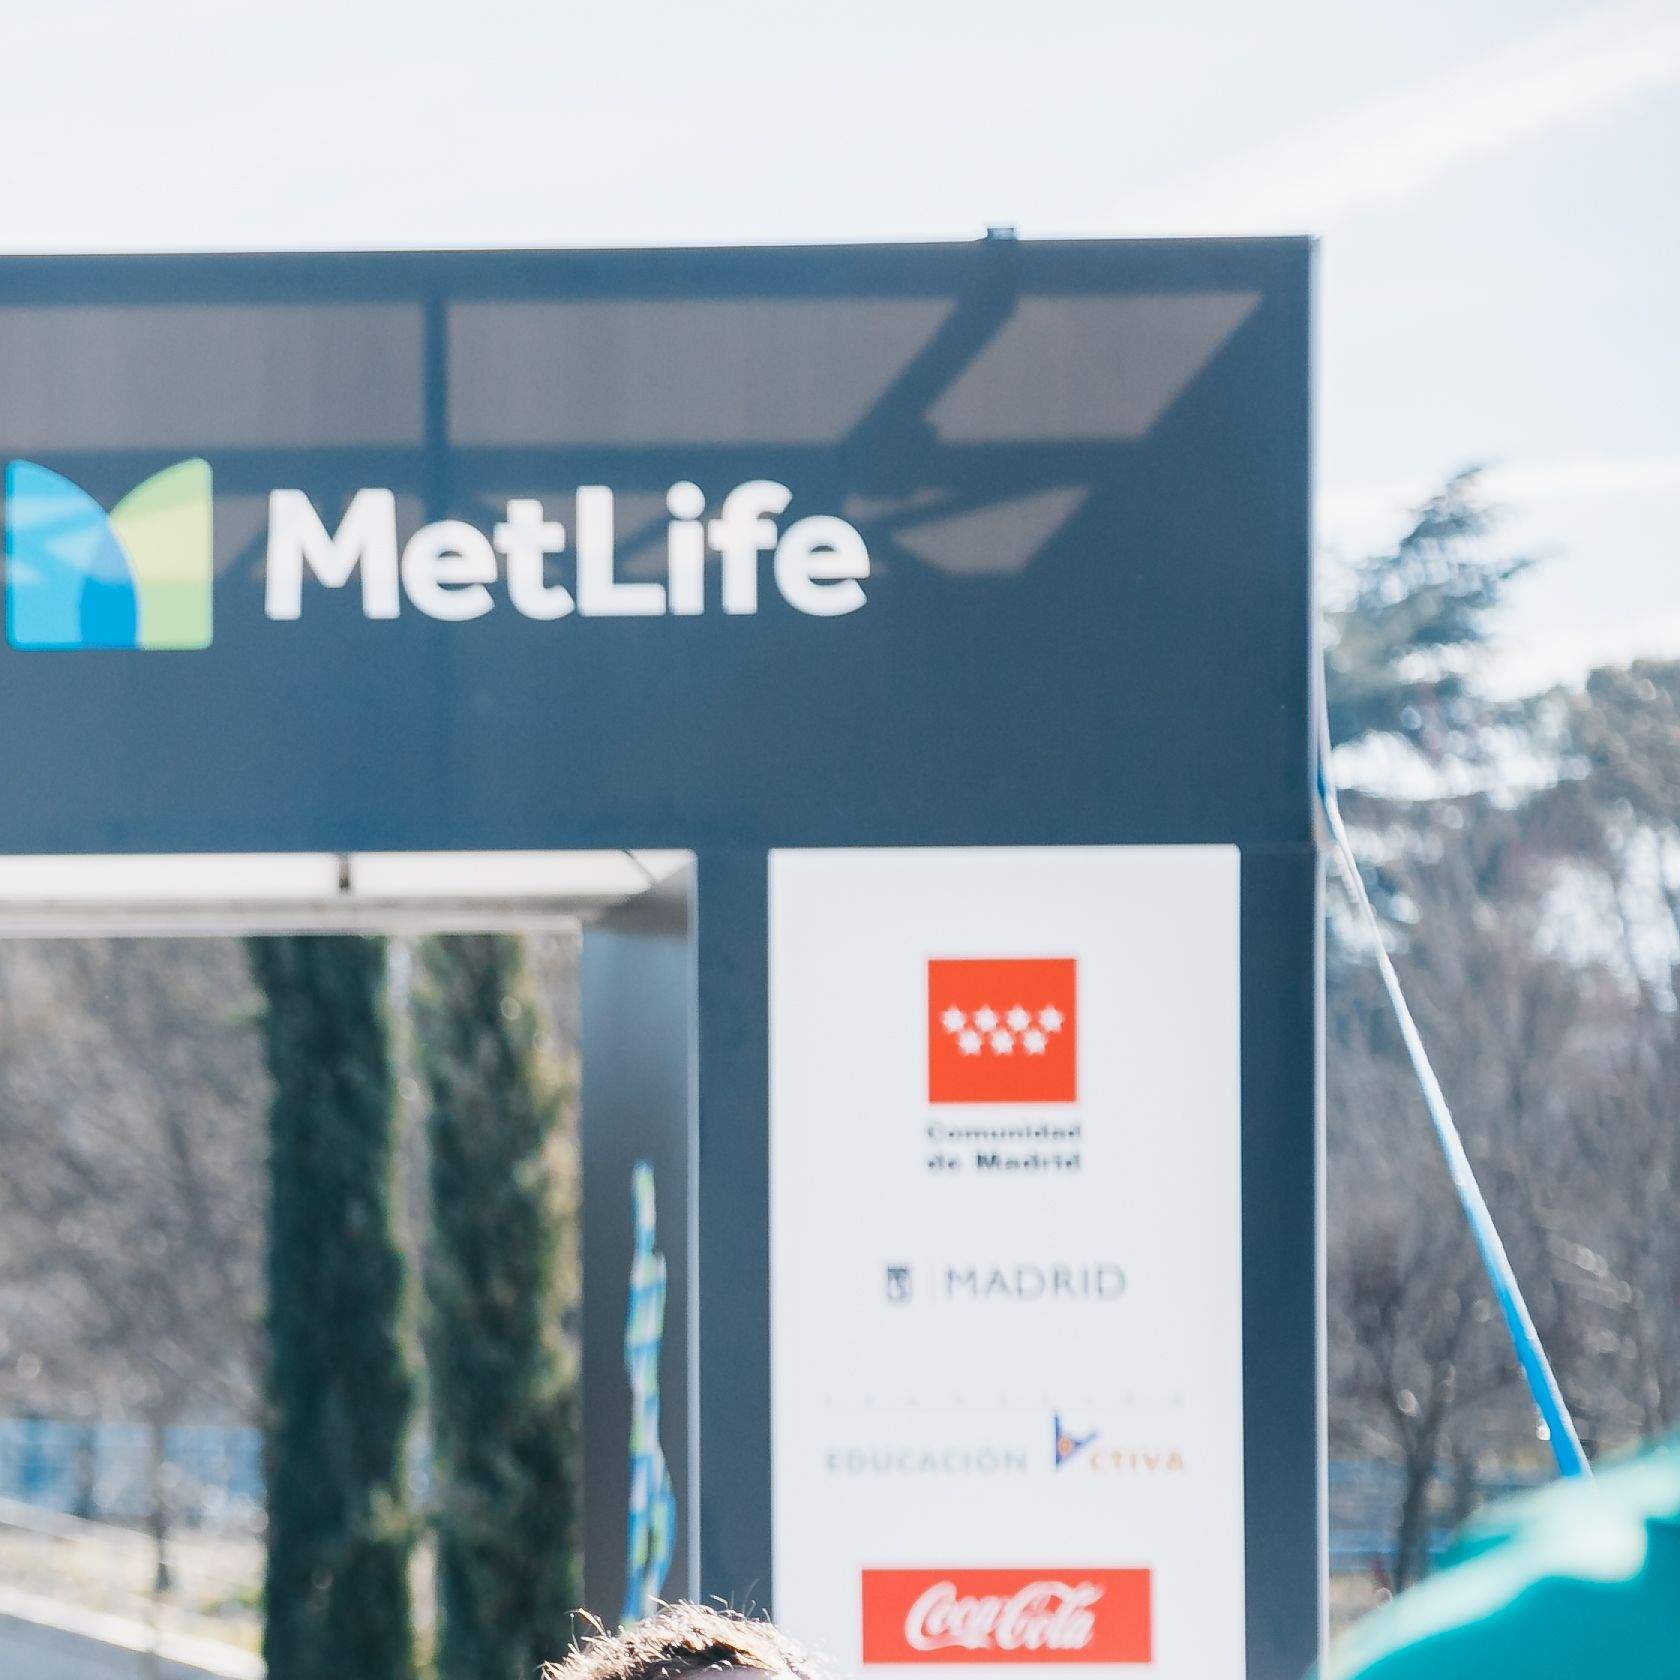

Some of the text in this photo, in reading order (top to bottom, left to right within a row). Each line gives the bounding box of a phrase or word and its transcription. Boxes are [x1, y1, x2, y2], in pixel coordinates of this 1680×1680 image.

[262, 478, 872, 621] MetLife
[975, 1152, 1081, 1172] Madrid
[945, 1264, 1128, 1301] MADRID
